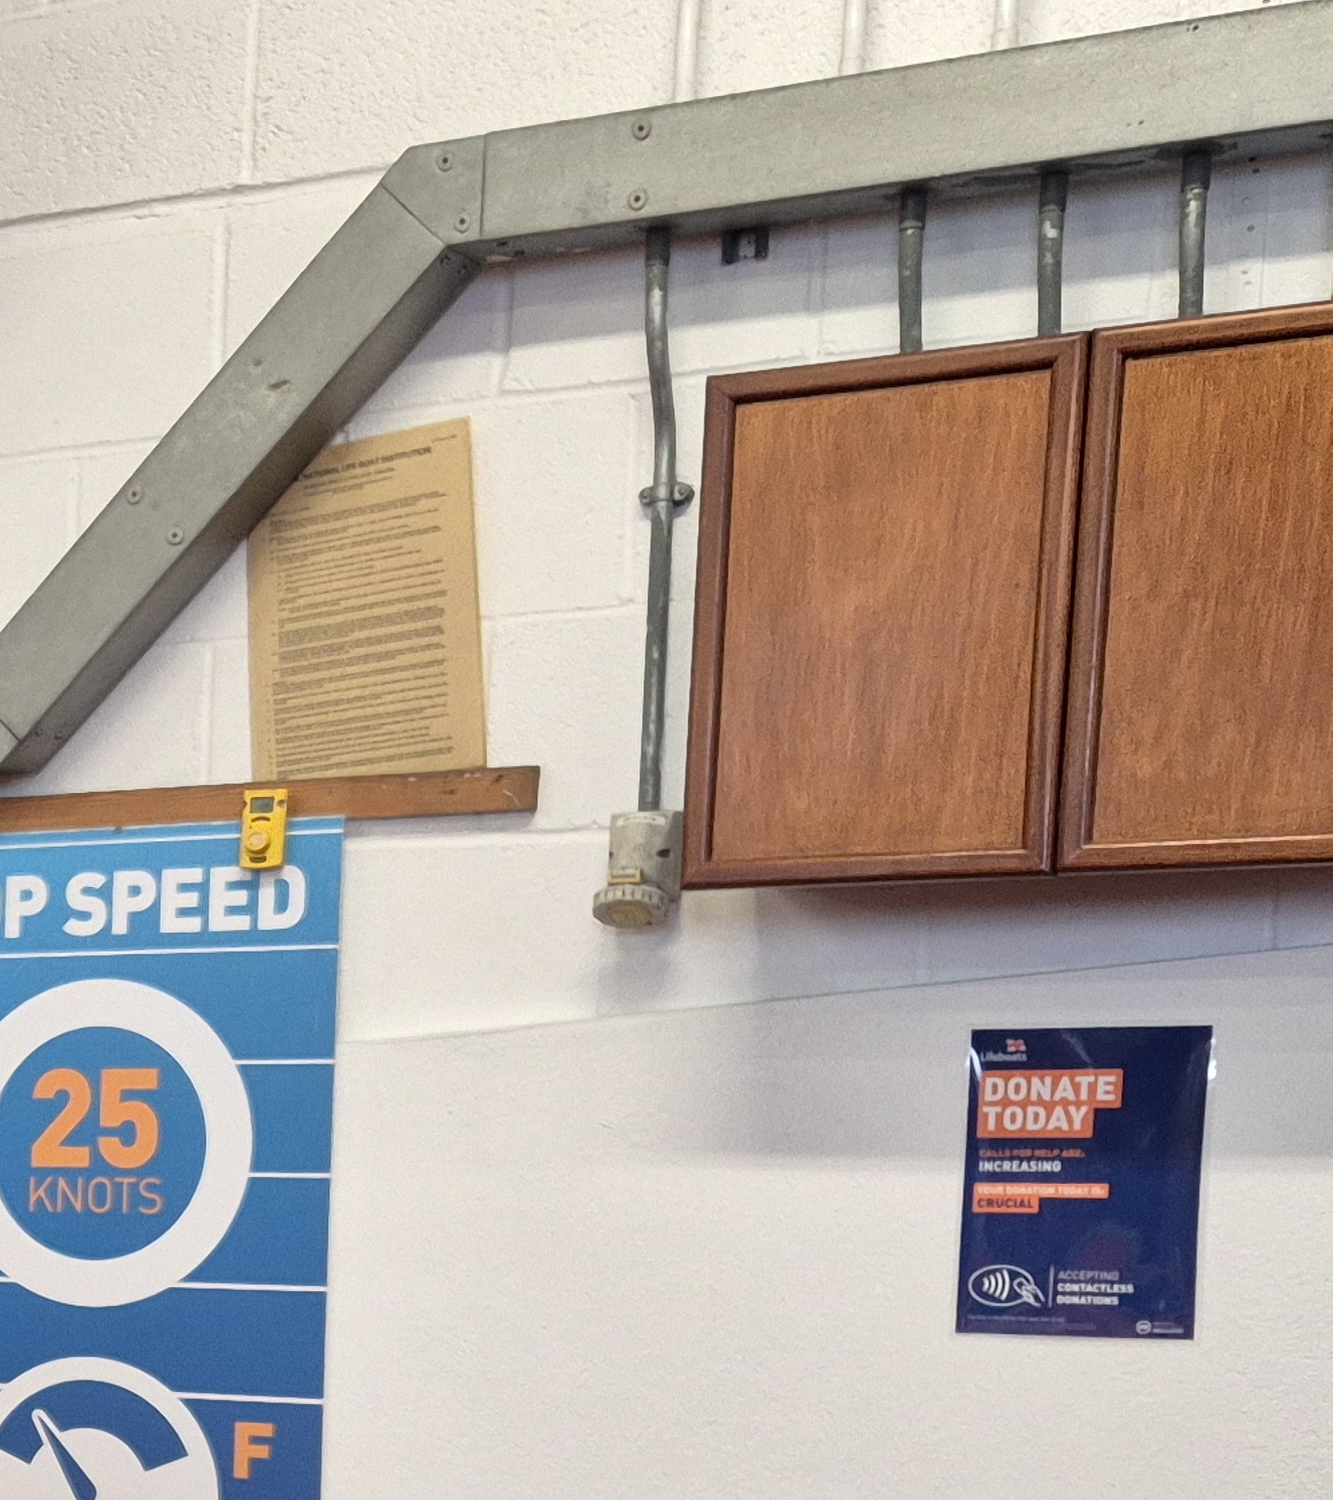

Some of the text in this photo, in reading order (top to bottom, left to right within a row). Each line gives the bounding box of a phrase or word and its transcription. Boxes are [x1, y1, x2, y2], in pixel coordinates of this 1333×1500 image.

[62, 863, 307, 938] SPEED
[983, 1075, 1117, 1102] DONATE
[29, 1067, 160, 1169] 25
[981, 1105, 1089, 1132] TODAY
[978, 1160, 1062, 1173] INCREASING
[27, 1175, 164, 1215] KNOTS
[976, 1197, 1035, 1210] CRUCIAL
[1056, 1283, 1135, 1294] CONTACTLESS
[1057, 1270, 1120, 1281] ACCEPTING
[1056, 1295, 1120, 1306] DONATIONS
[232, 1421, 274, 1479] F
